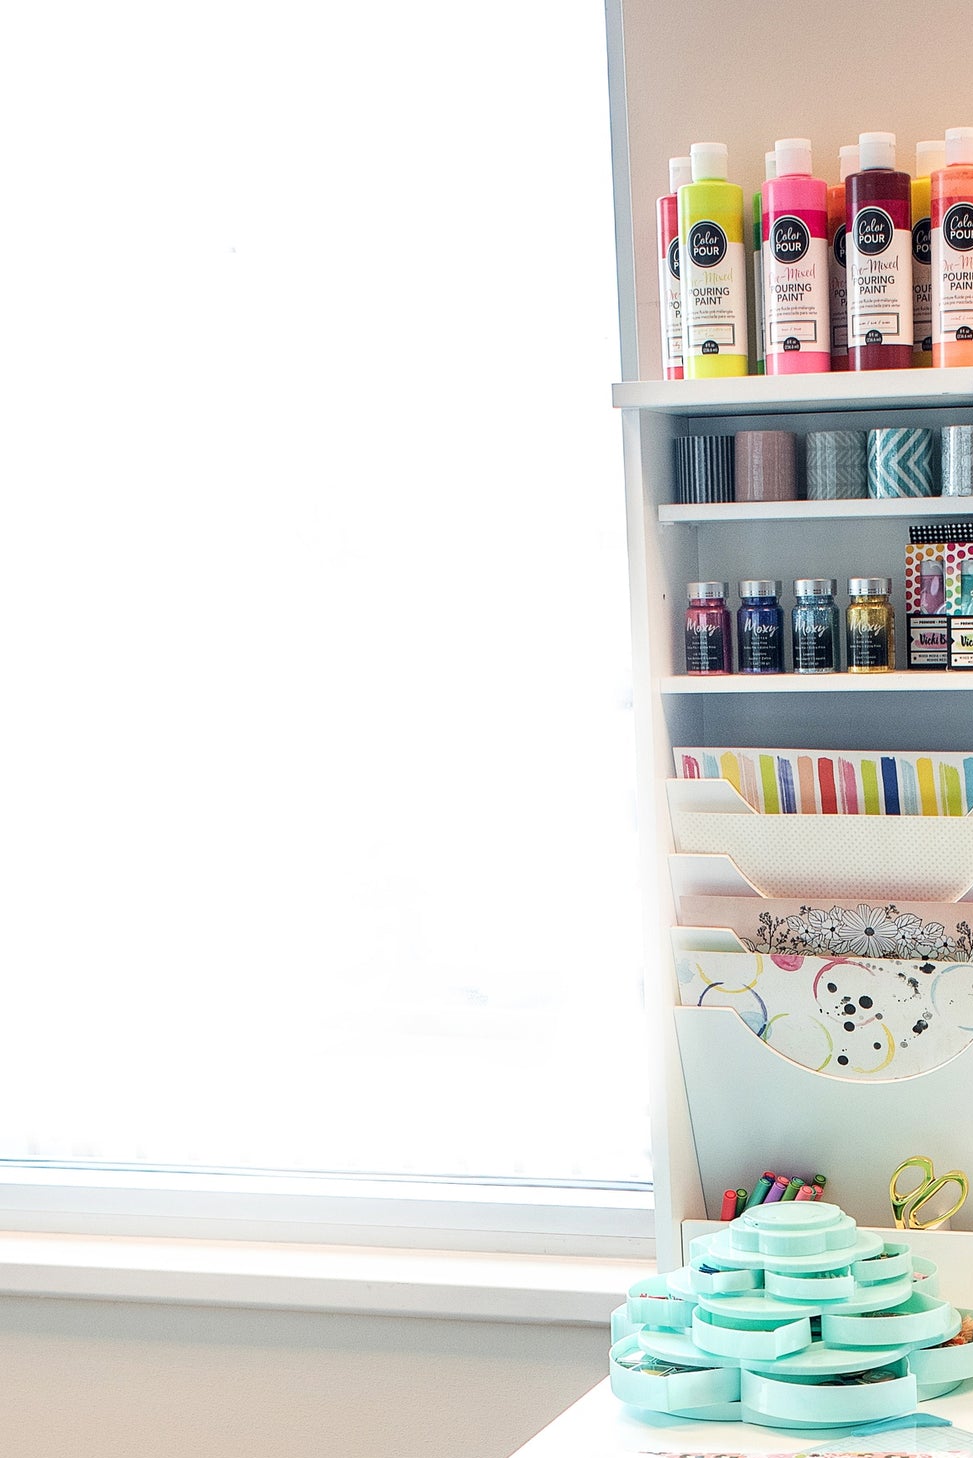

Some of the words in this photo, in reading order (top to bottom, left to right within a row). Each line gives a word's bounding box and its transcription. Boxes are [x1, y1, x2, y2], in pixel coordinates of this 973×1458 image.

[859, 218, 886, 233] Color
[693, 231, 719, 247] Color
[775, 227, 802, 243] Color
[859, 234, 886, 244] POUR
[693, 246, 719, 257] POUR
[775, 242, 802, 253] POUR
[851, 255, 899, 277] Pe-Mixed
[769, 263, 816, 285] Pe-Mixed
[777, 292, 804, 303] PAINT
[860, 285, 888, 295] PAINT
[695, 297, 722, 306] PAINT
[687, 617, 720, 637] Moxy
[744, 617, 779, 637] Moxy
[795, 618, 829, 638] Moxy
[850, 617, 886, 636] Moxy
[919, 633, 939, 645] Vicki
